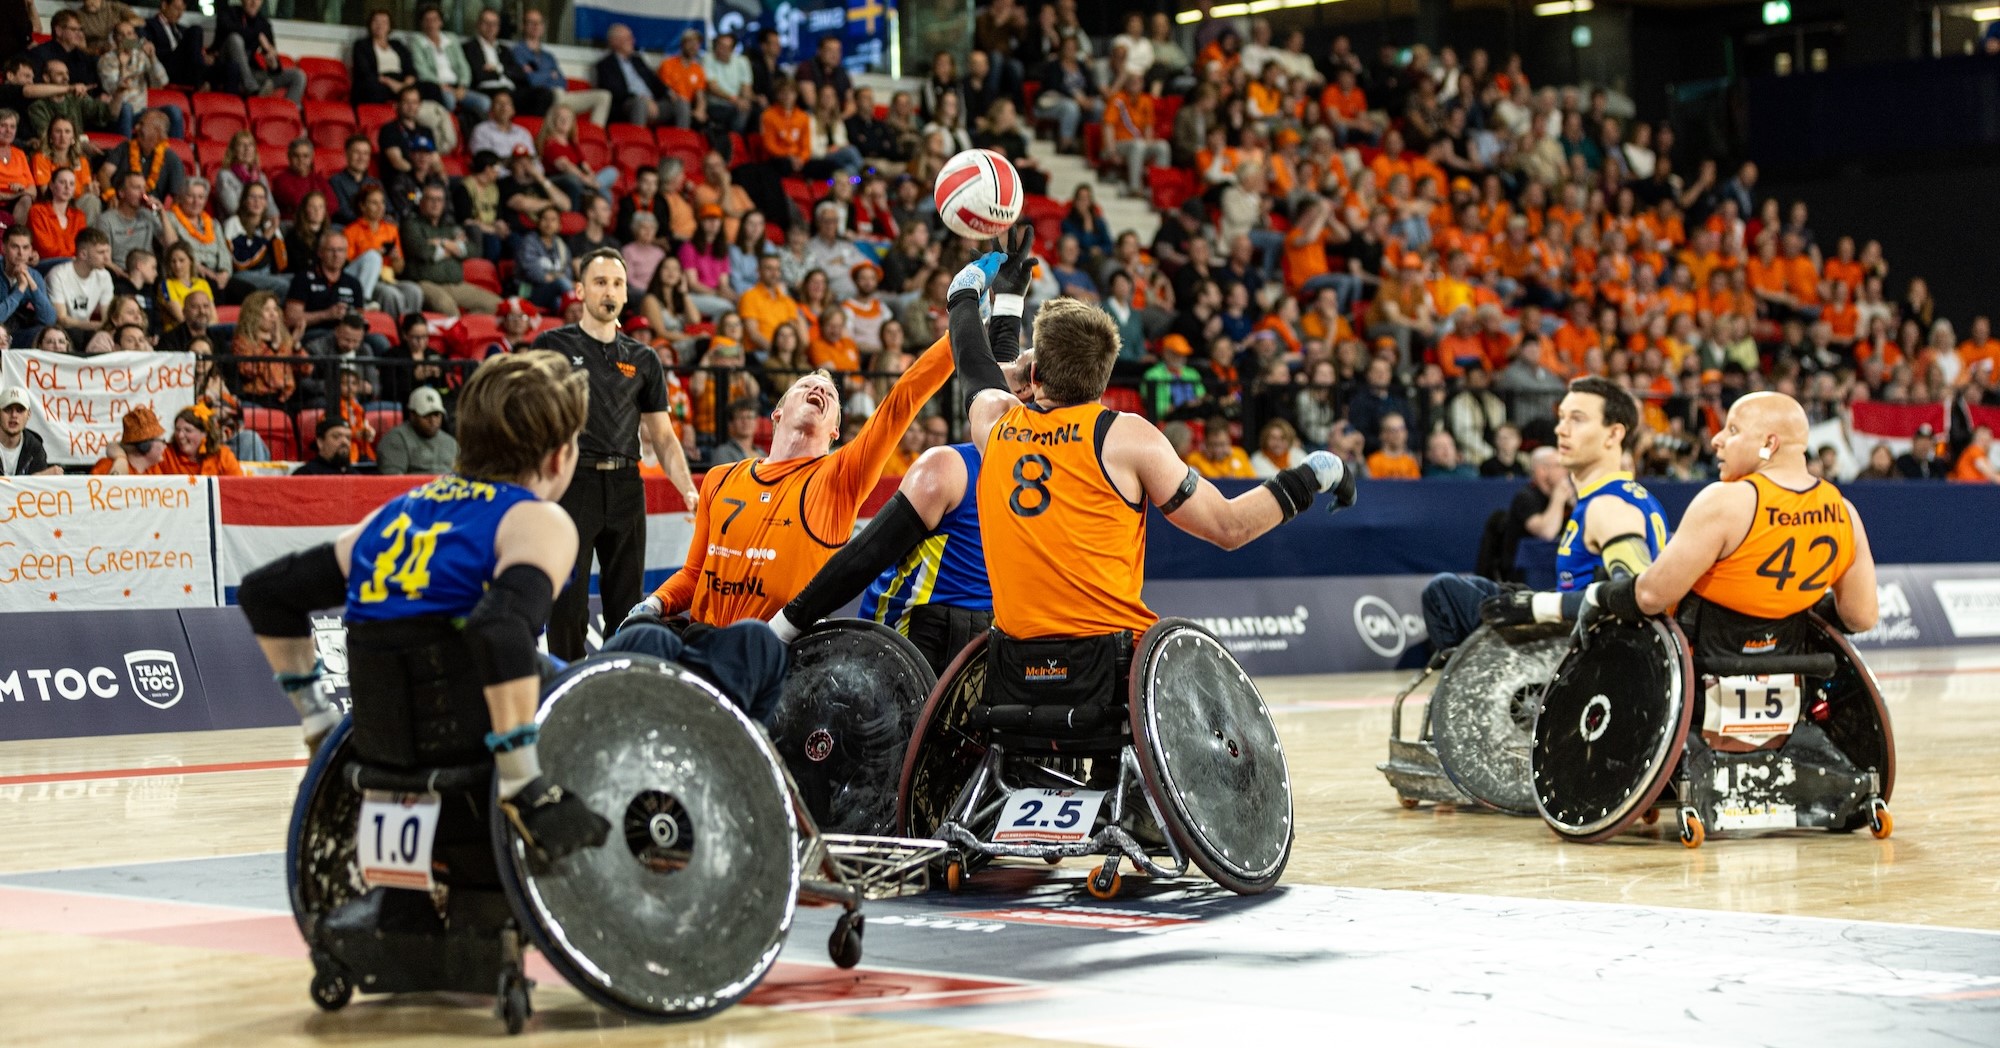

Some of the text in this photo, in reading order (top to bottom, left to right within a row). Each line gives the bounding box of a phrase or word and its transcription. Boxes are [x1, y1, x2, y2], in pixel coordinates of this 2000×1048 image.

[997, 422, 1083, 446] TeamNL
[87, 479, 190, 511] Remmen
[1009, 454, 1053, 517] 8
[721, 498, 747, 535] 7
[1765, 502, 1844, 526] TeamNL
[359, 512, 453, 603] 34
[1756, 535, 1838, 591] 42
[27, 666, 119, 701] TOC
[135, 664, 172, 677] TEAM
[138, 676, 175, 691] TOC
[1026, 666, 1067, 676] Melrose
[1735, 688, 1783, 719] 1.5
[1013, 800, 1083, 828] 2.5
[374, 813, 420, 863] 1.0
